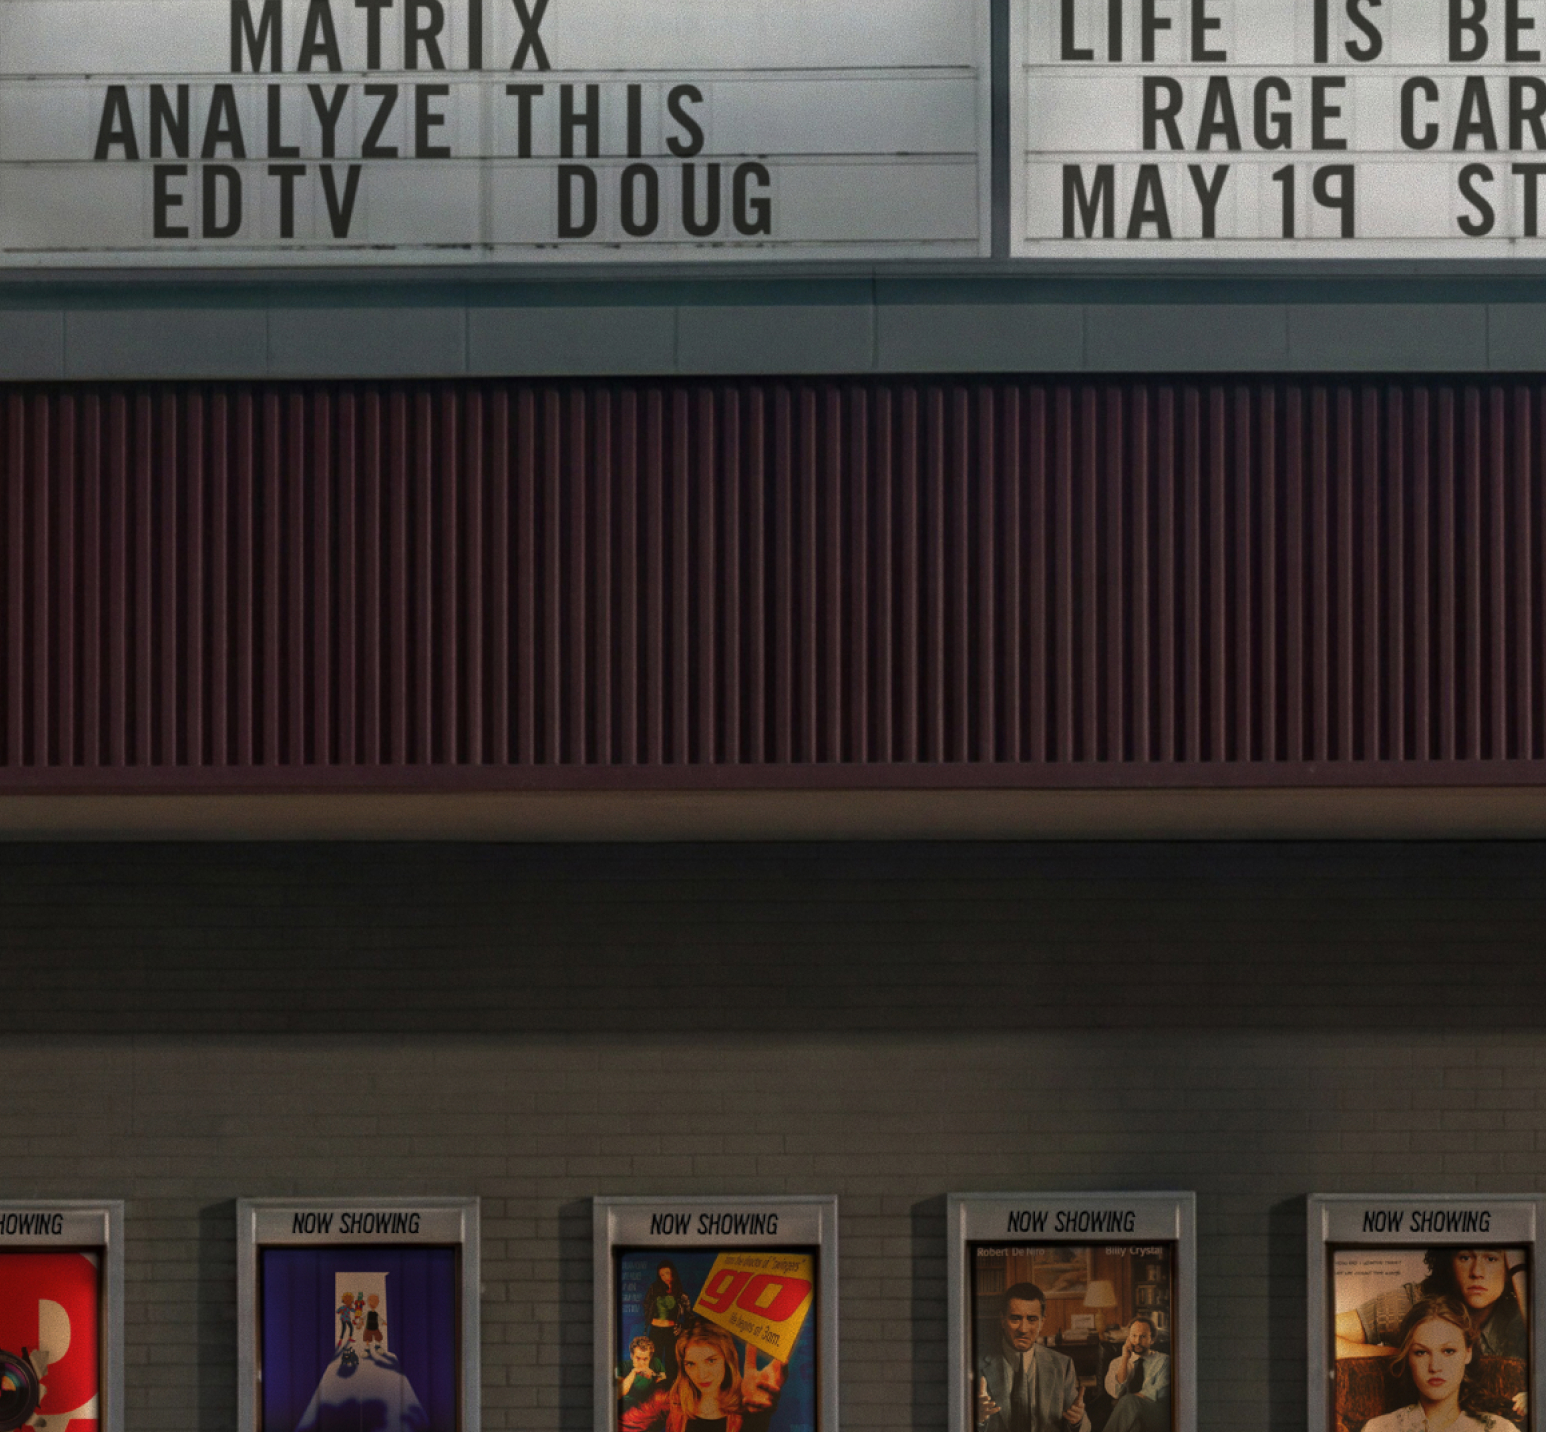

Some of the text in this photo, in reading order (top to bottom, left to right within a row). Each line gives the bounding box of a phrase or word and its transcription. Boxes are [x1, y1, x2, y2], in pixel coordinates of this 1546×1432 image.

[230, 0, 552, 73] MATRIX
[1061, 0, 1227, 63] LIFE
[1313, 0, 1384, 63] IS
[94, 83, 708, 161] ANALYZE THIS
[1141, 75, 1349, 152] RAGE
[152, 162, 775, 242] EDTV DOUG
[1061, 163, 1230, 240] MAY
[292, 1212, 421, 1234] NOW SHOWING
[650, 1213, 779, 1235] NOW SHOWING
[1007, 1210, 1135, 1232] NOW SHOWING
[1362, 1210, 1491, 1232] NOW SHOWING
[698, 1268, 812, 1322] go
